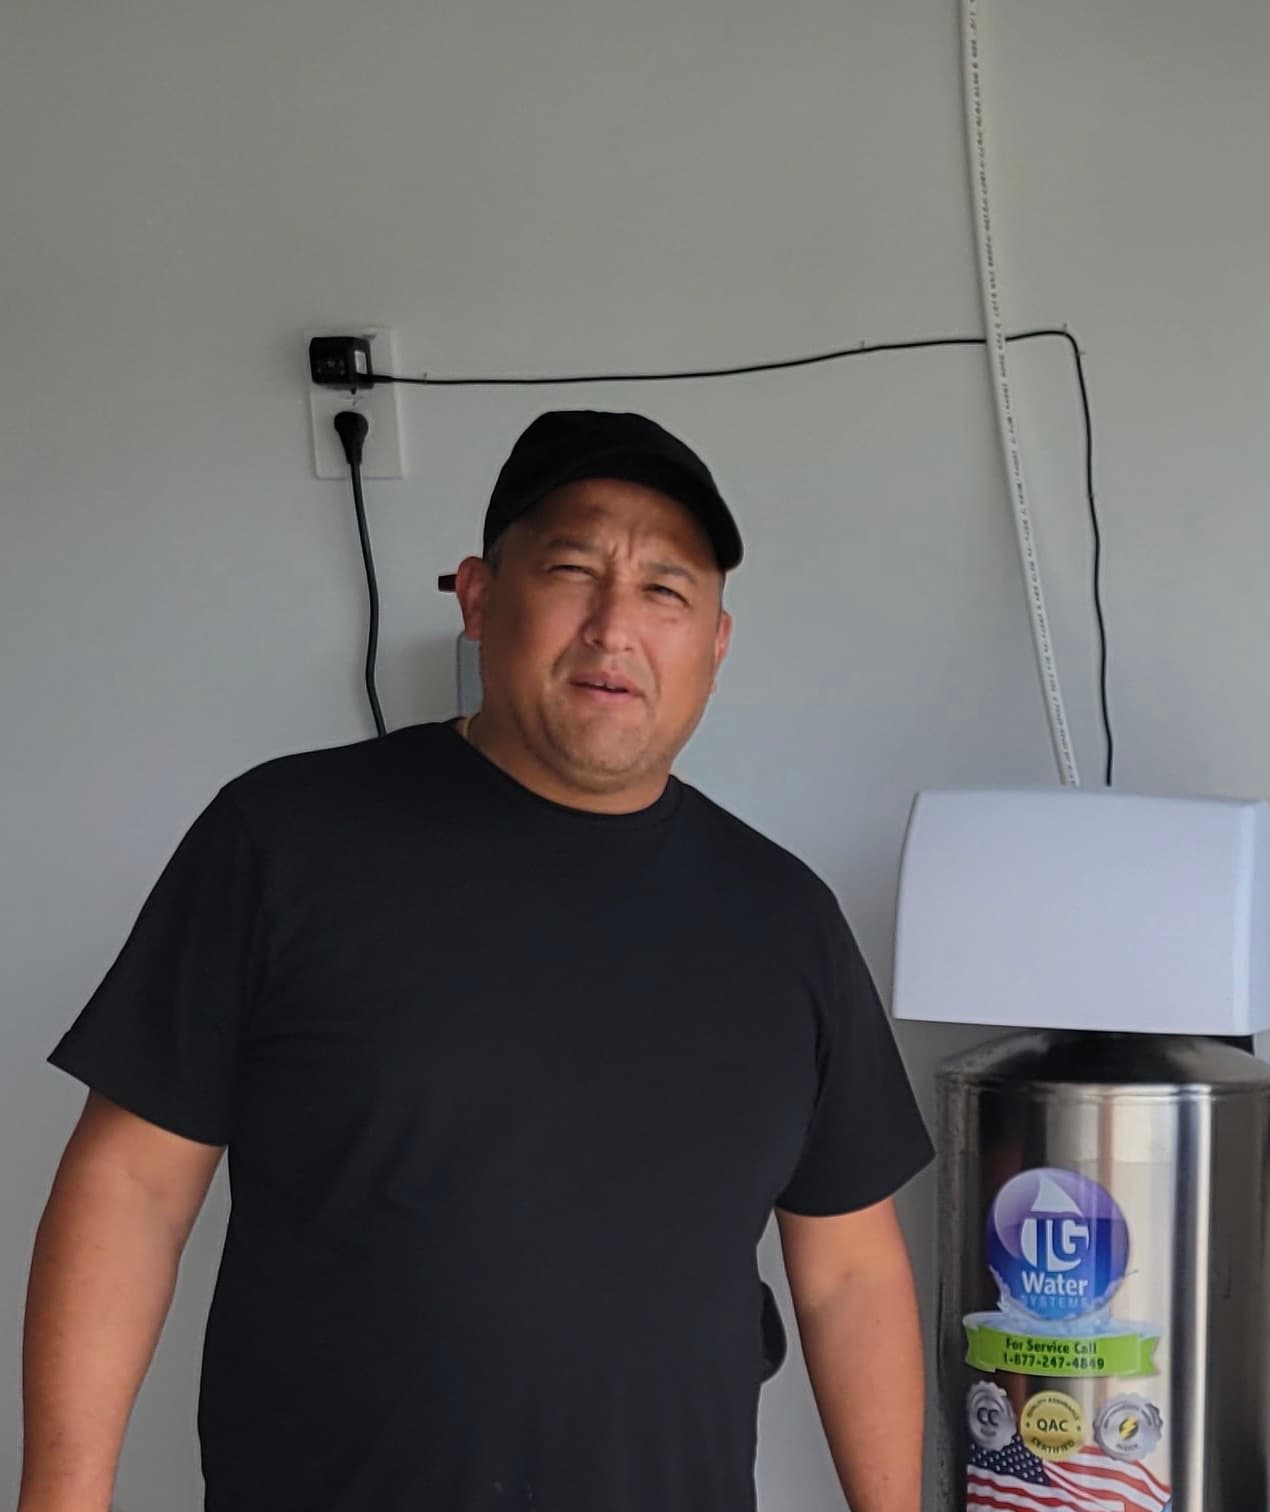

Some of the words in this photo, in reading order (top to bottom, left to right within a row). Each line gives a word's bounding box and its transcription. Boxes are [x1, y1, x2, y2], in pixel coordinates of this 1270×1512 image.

[1021, 1271, 1089, 1297] Water
[1005, 1337, 1023, 1350] For
[1027, 1338, 1070, 1355] Service
[1074, 1341, 1097, 1355] Call
[1036, 1418, 1069, 1433] QAC
